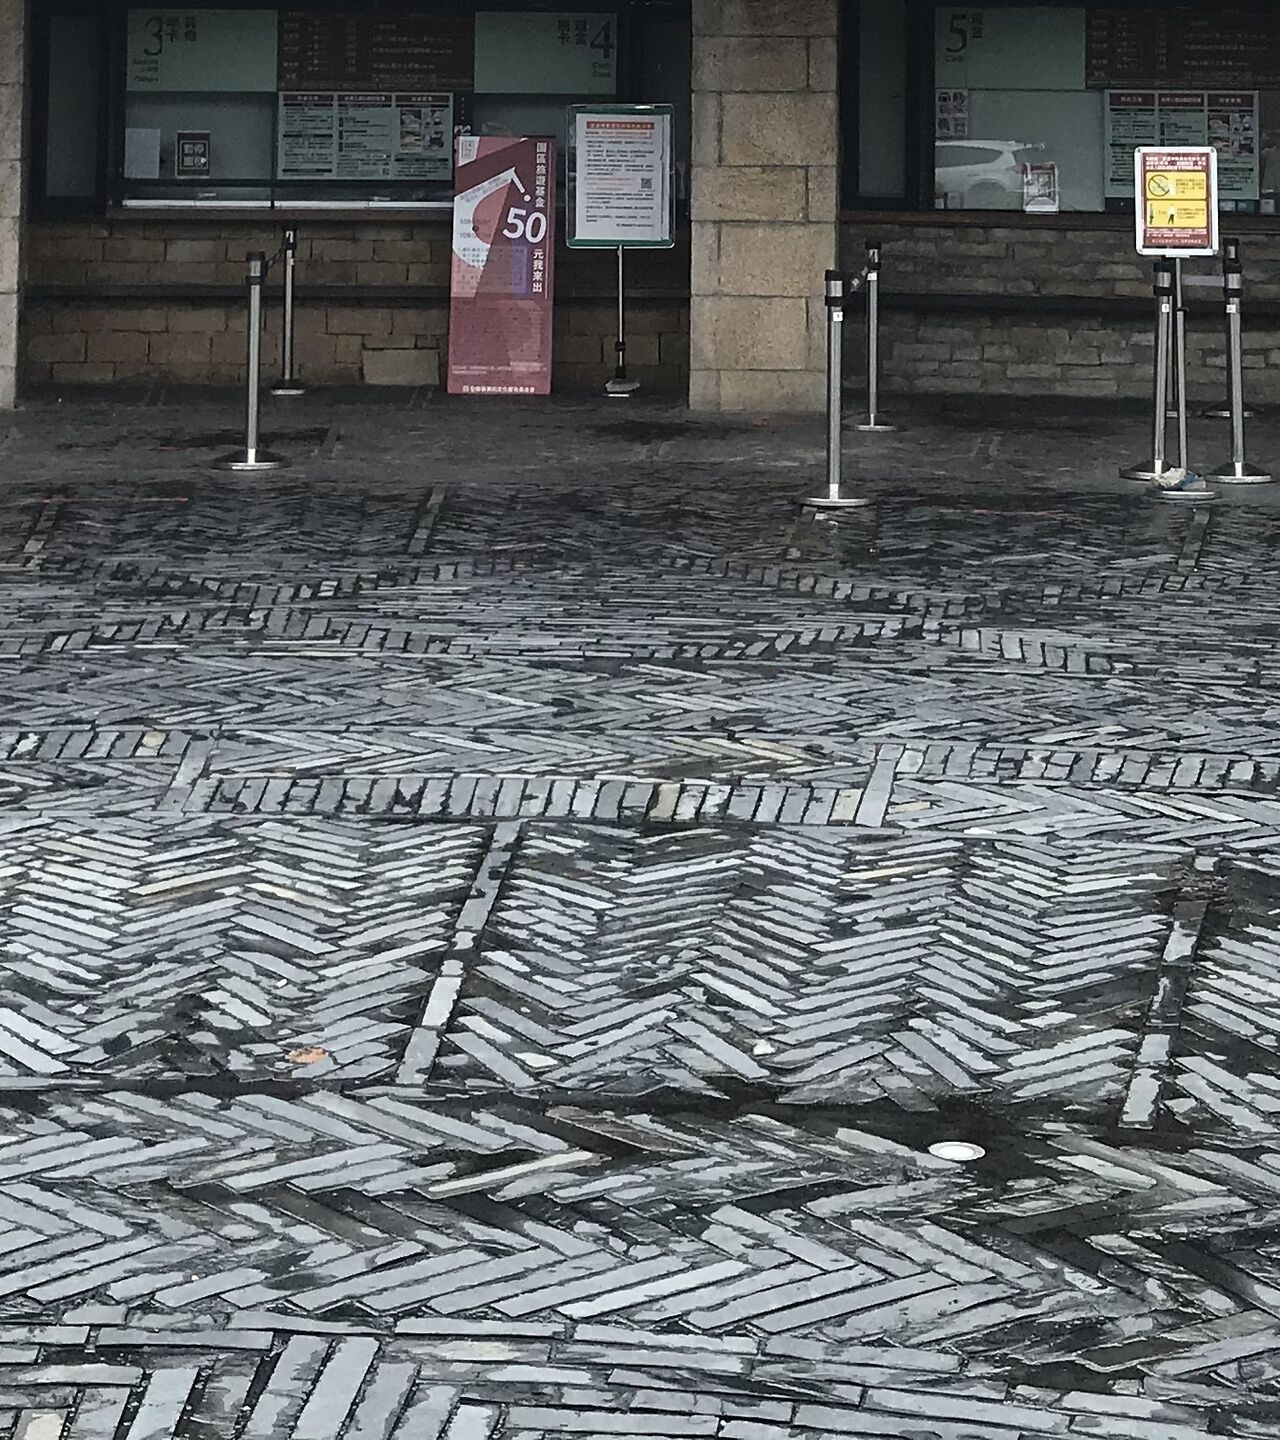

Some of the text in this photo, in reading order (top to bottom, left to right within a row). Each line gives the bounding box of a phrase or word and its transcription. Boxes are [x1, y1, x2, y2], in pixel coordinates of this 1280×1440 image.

[143, 16, 163, 56] 3
[590, 20, 615, 58] 4
[945, 13, 968, 53] 5
[502, 206, 547, 244] 50
